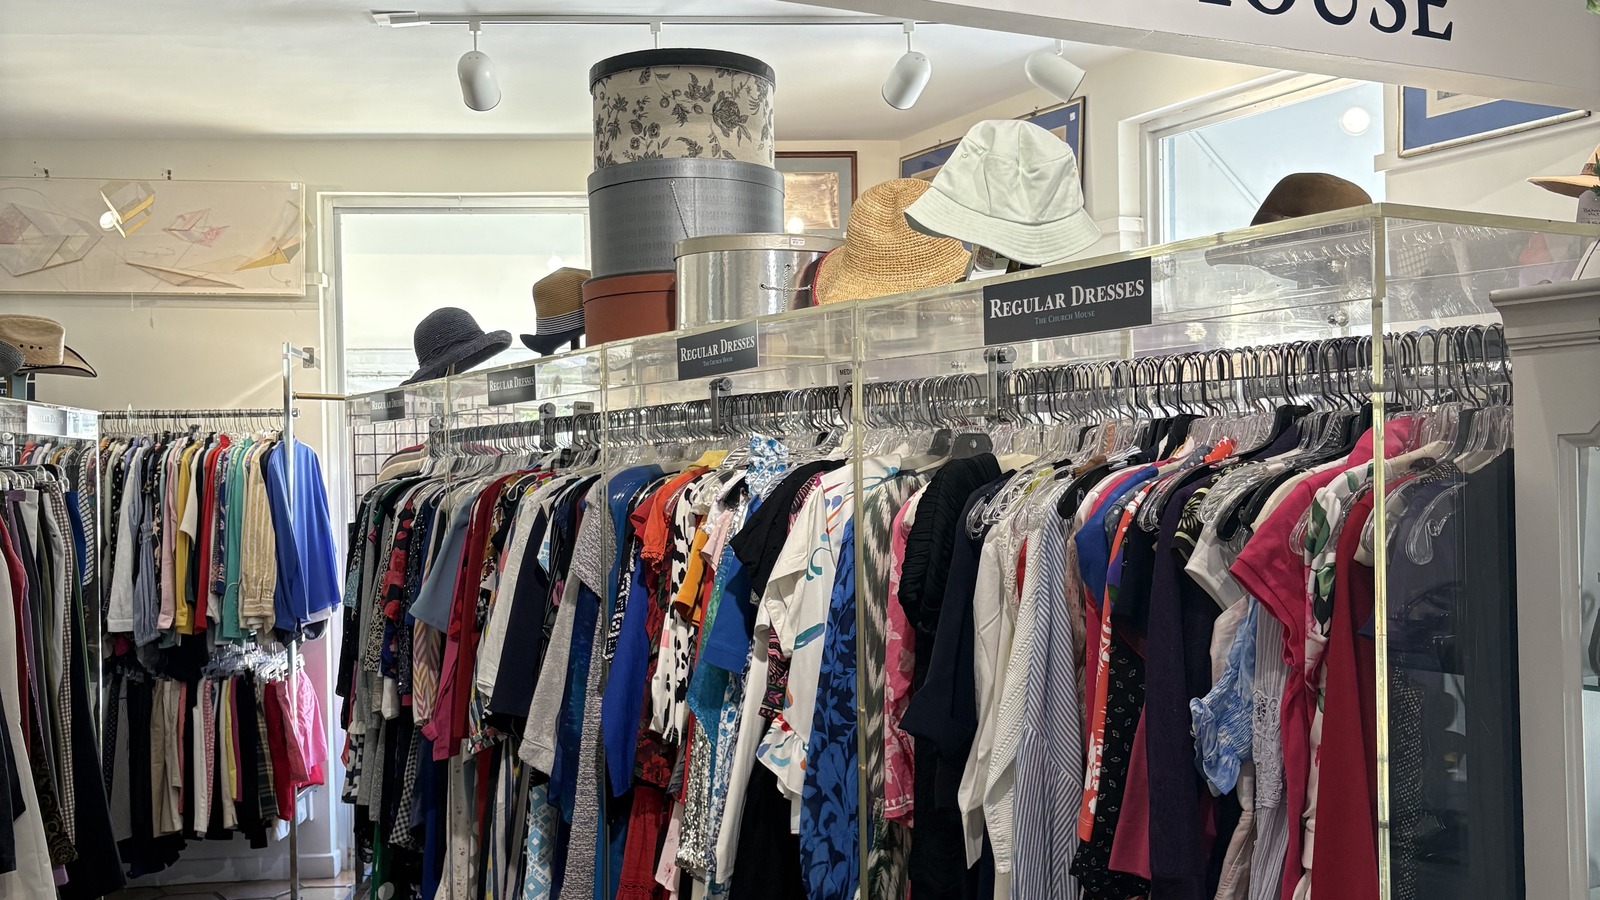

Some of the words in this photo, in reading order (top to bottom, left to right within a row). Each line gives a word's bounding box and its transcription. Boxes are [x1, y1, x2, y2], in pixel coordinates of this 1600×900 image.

[989, 293, 1066, 319] REGULAR
[1070, 279, 1145, 307] DRESSES
[680, 344, 719, 362] REGULAR
[720, 335, 755, 354] DRESSES
[489, 380, 513, 392] REGULAR
